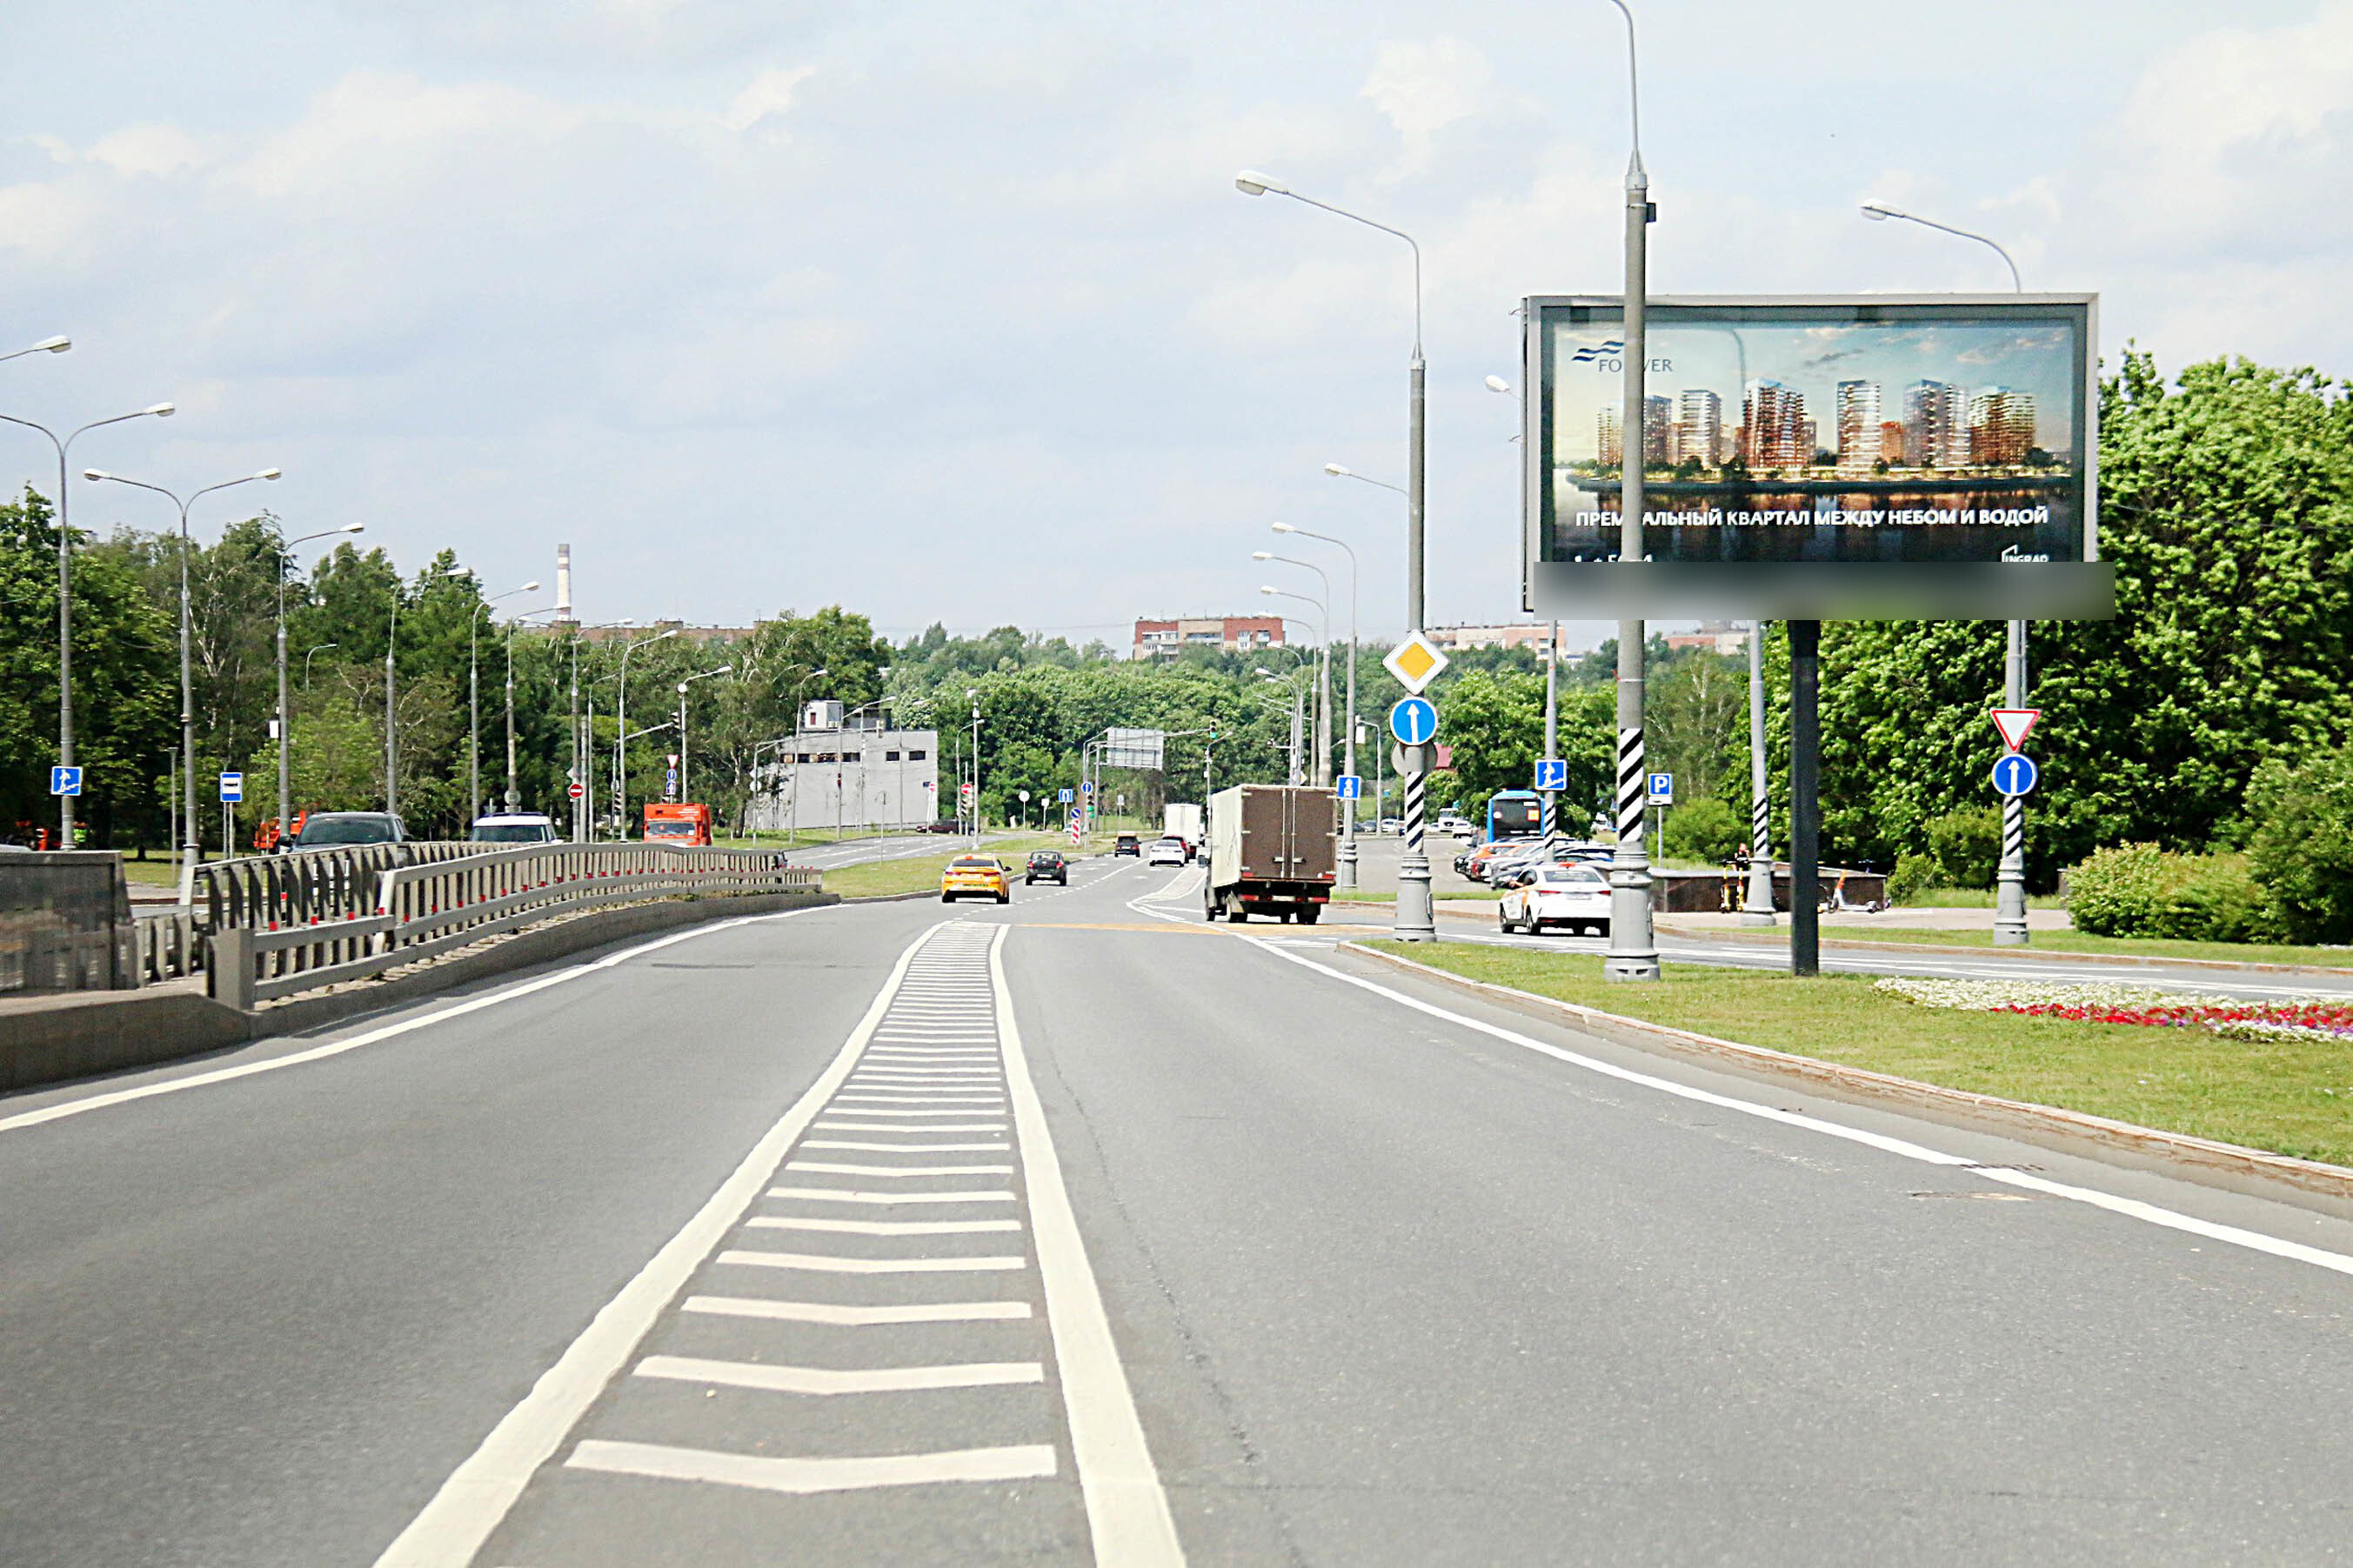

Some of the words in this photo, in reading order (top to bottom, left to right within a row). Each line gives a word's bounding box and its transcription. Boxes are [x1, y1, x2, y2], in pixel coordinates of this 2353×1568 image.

[1575, 508, 1722, 527] ПРЕМАЛЬНЫЙ
[1727, 510, 1809, 526] КВАРТАЛ
[1814, 510, 1885, 527] МЕЖДУ
[1888, 509, 1956, 524] НЕБОМ
[1961, 509, 1975, 524] И
[1979, 505, 2048, 526] ВОДОЙ
[1654, 776, 1668, 793] P
